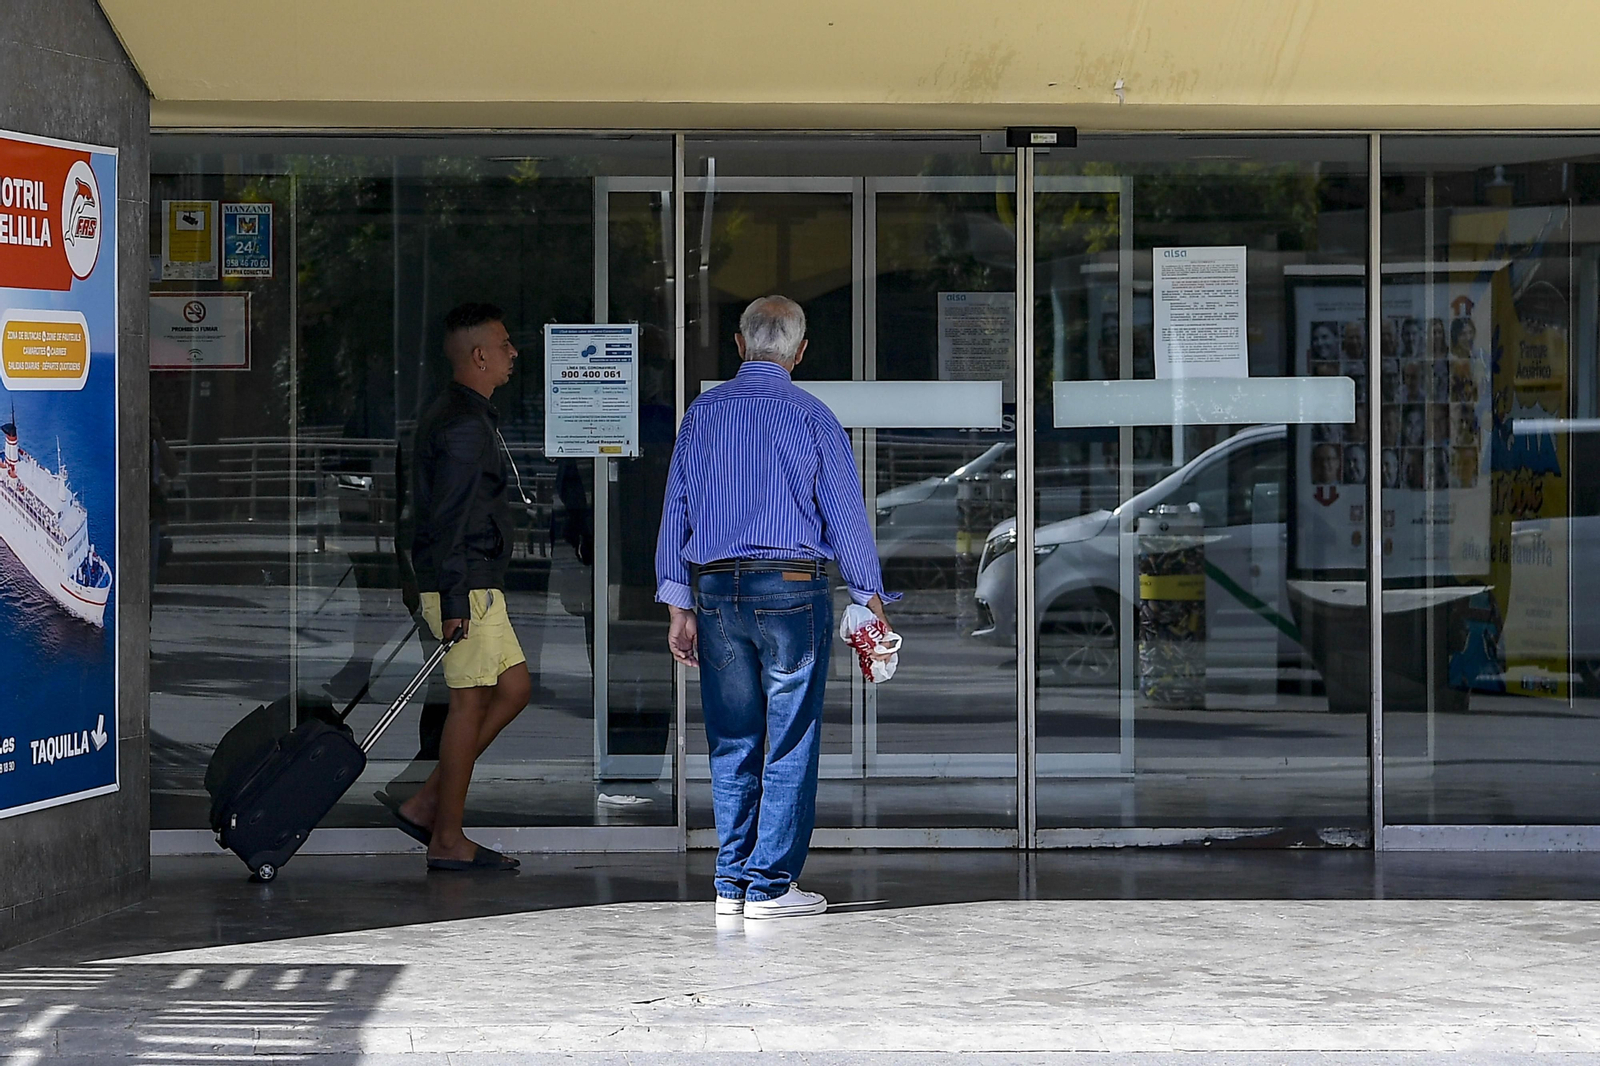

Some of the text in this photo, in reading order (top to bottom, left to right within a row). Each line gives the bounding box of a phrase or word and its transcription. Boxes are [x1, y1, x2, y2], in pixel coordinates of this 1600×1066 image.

[0, 176, 48, 211] OTRIL
[225, 205, 271, 213] MANZANO
[75, 218, 97, 237] FRS
[1163, 249, 1187, 258] alsa
[226, 259, 239, 267] 958
[250, 259, 259, 267] 70
[946, 293, 967, 301] alsa
[1519, 340, 1548, 359] Parque
[561, 370, 622, 379] 900 400 061
[0, 737, 15, 755] es
[30, 730, 90, 766] TAQUILLA
